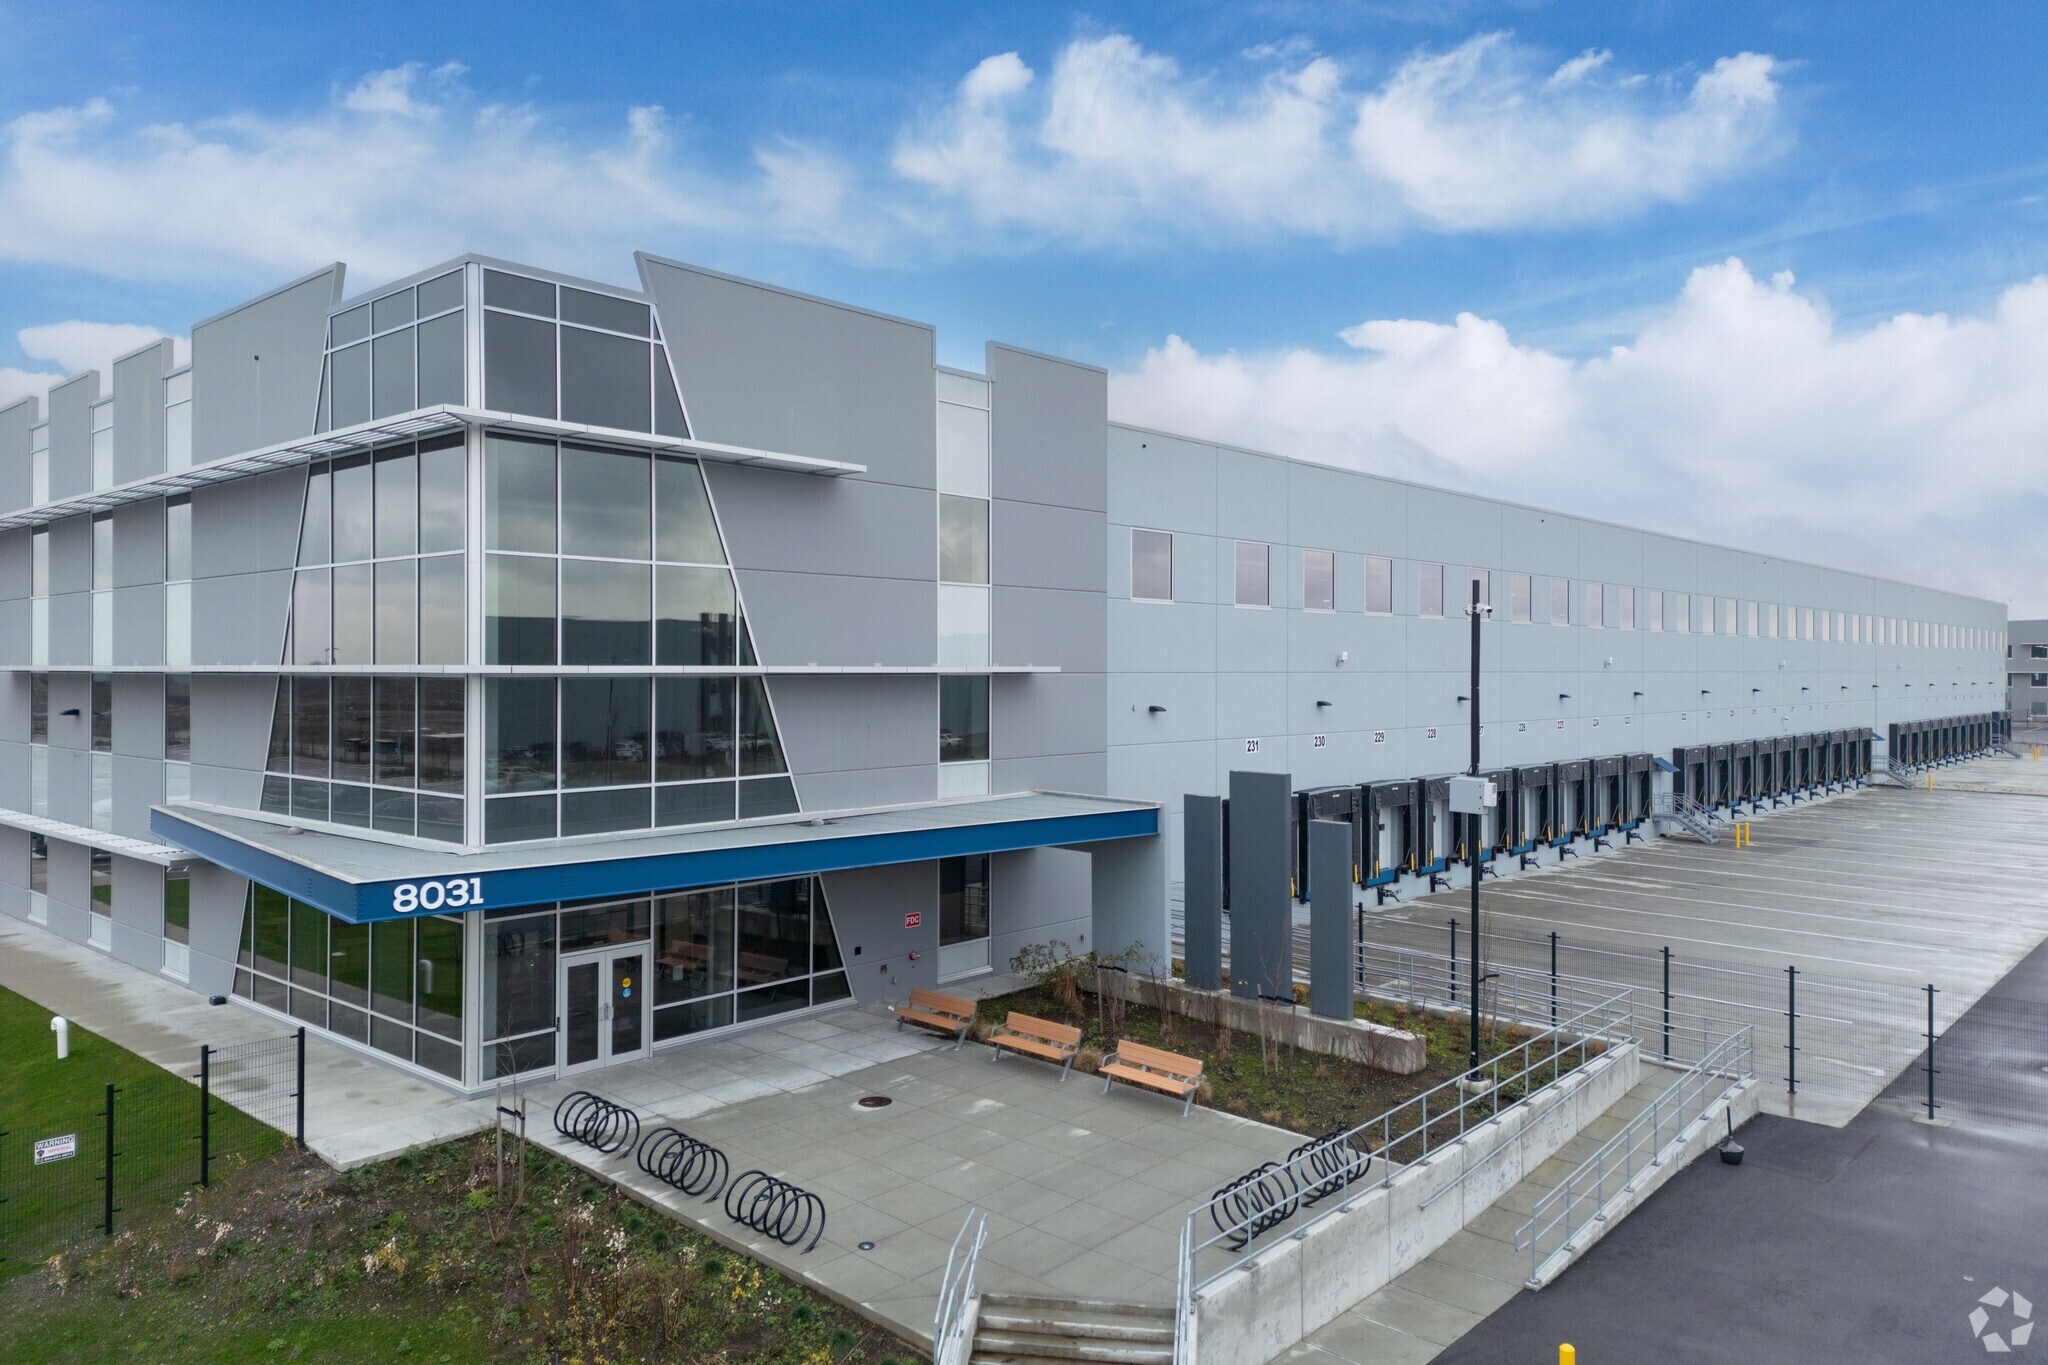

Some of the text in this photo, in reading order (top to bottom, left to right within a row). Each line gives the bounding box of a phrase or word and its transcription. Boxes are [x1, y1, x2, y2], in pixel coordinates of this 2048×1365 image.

[1374, 732, 1384, 742] 229
[1427, 728, 1436, 738] 228
[1247, 740, 1259, 752] 231
[1314, 736, 1325, 747] 230
[392, 877, 484, 912] 8031
[906, 915, 919, 925] FDC
[37, 1136, 74, 1149] WARNING
